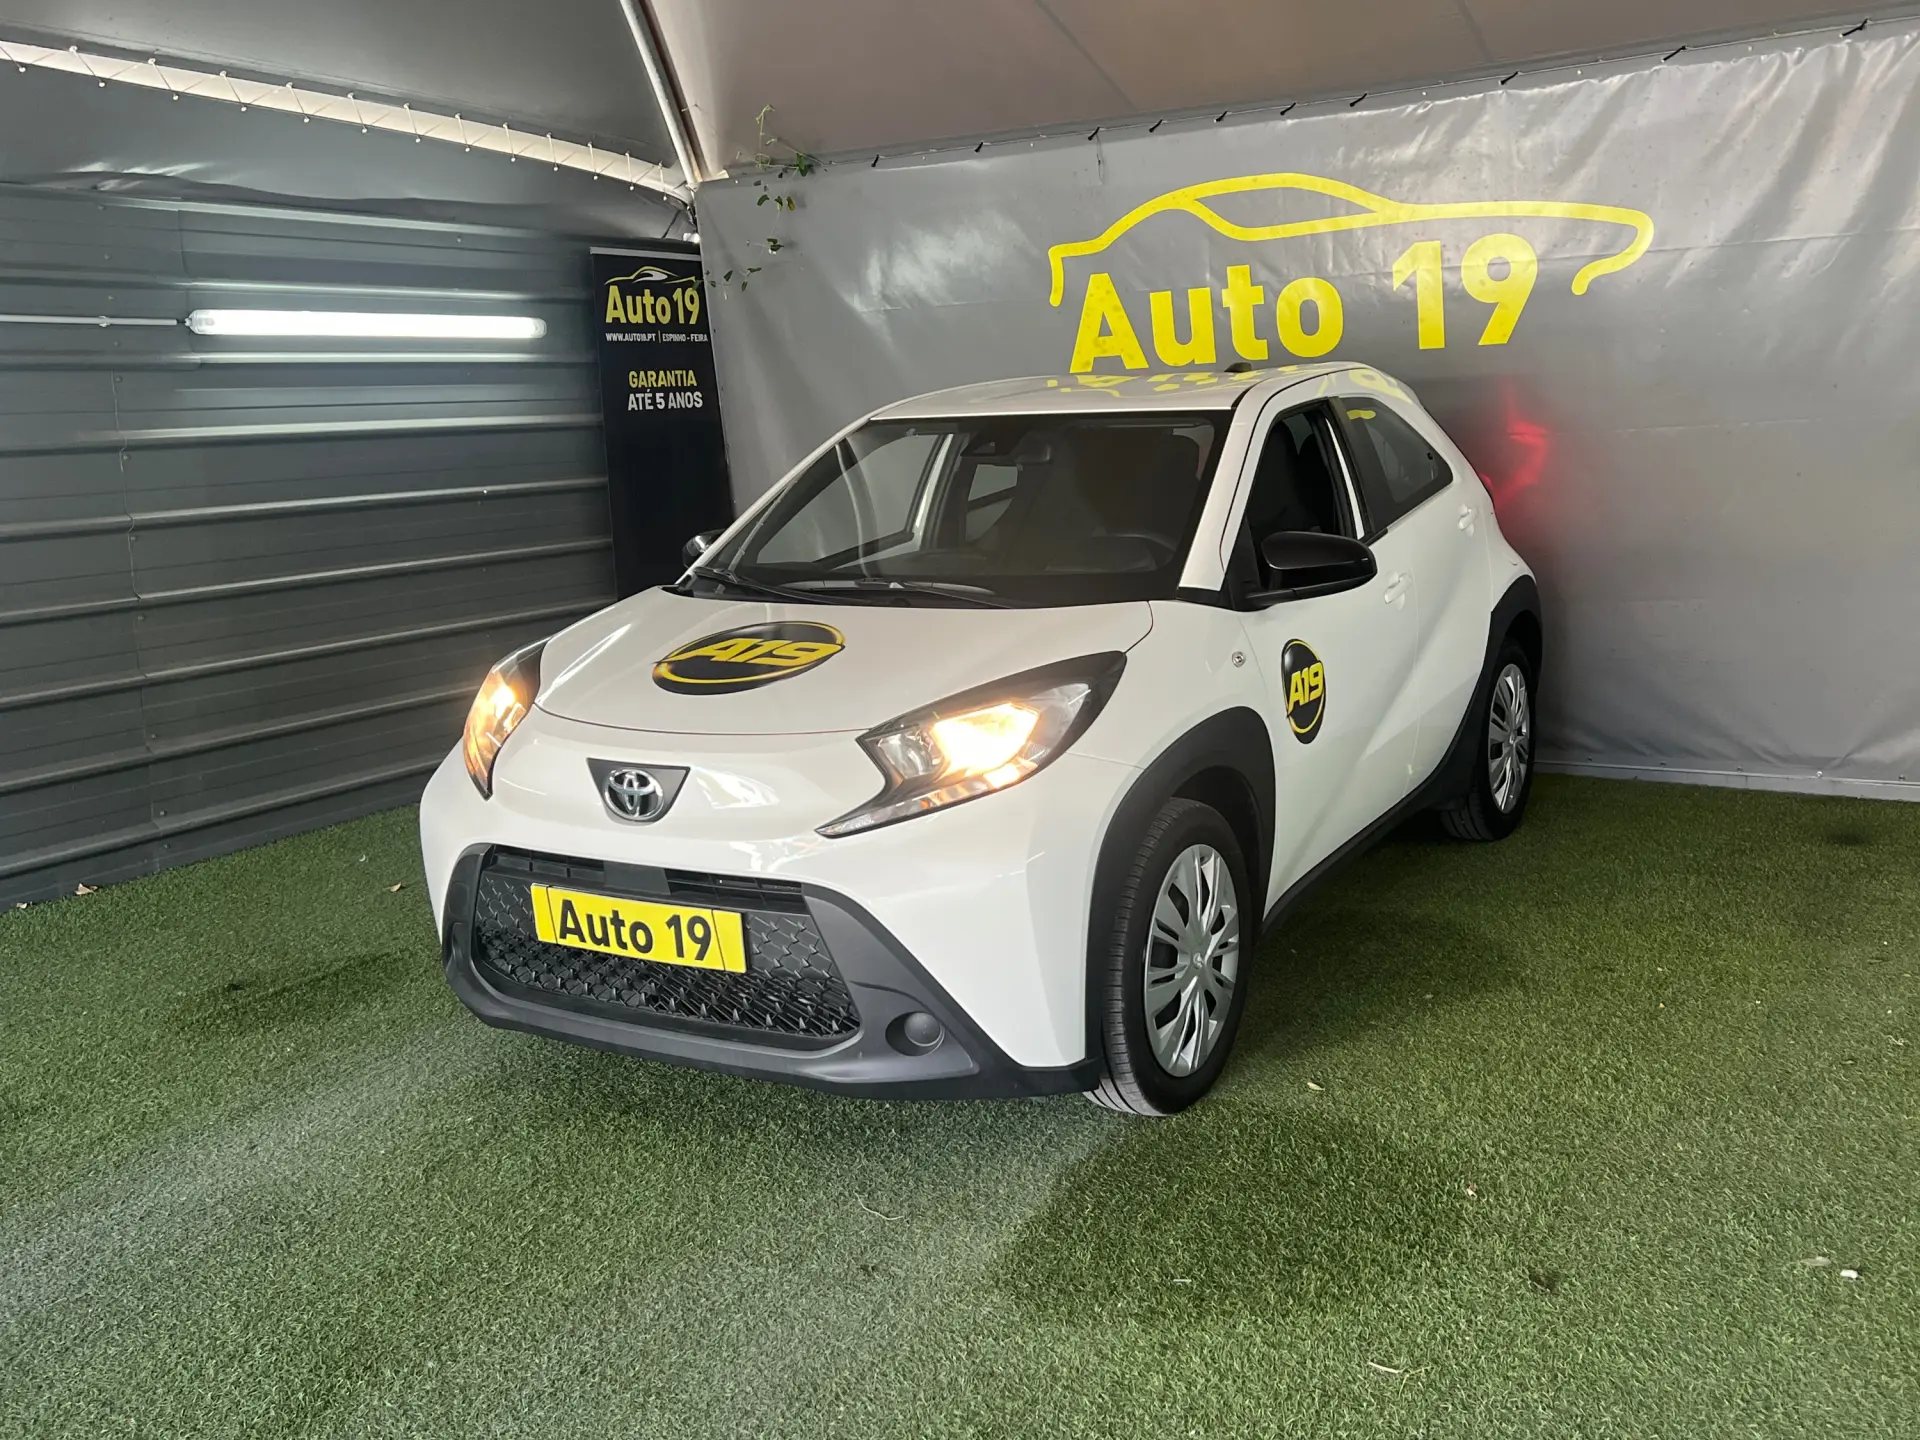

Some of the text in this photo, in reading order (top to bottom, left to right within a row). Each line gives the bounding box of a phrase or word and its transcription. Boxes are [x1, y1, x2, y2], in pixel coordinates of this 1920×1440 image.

[605, 285, 700, 325] Auto 19
[1069, 233, 1538, 374] Auto 19
[690, 334, 708, 342] FEIRA
[628, 369, 697, 388] GARANTIA
[627, 389, 703, 411] ATÉ 5 ANOS
[662, 637, 842, 667] A19
[1288, 662, 1324, 714] A19
[559, 899, 712, 961] Auto 19
